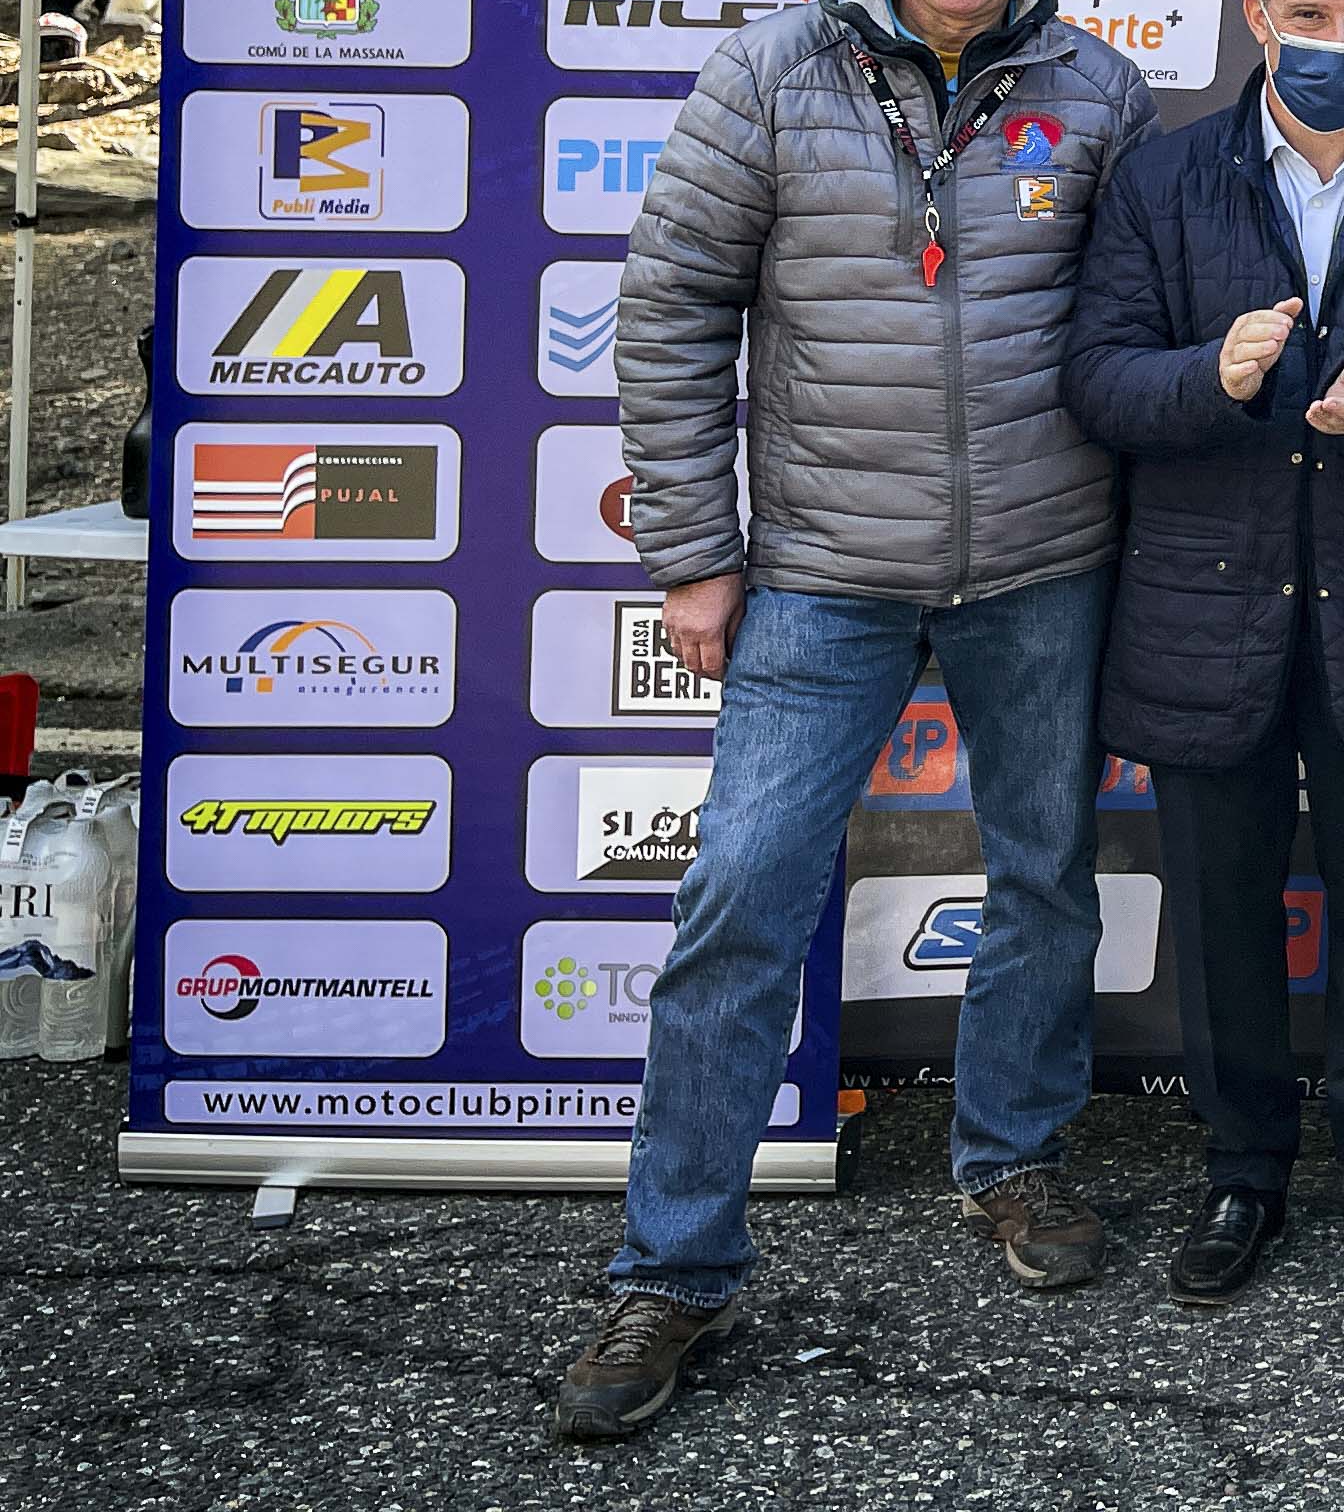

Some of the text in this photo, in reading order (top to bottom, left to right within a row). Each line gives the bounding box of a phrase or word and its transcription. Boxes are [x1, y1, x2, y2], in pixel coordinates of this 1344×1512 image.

[247, 43, 405, 60] COMÚ DE LA MASSANA
[272, 198, 315, 215] Publi
[209, 361, 426, 385] MERCAUTO
[320, 488, 399, 503] PUJAL
[632, 619, 650, 657] CASA
[183, 655, 440, 675] MULTISEGUR
